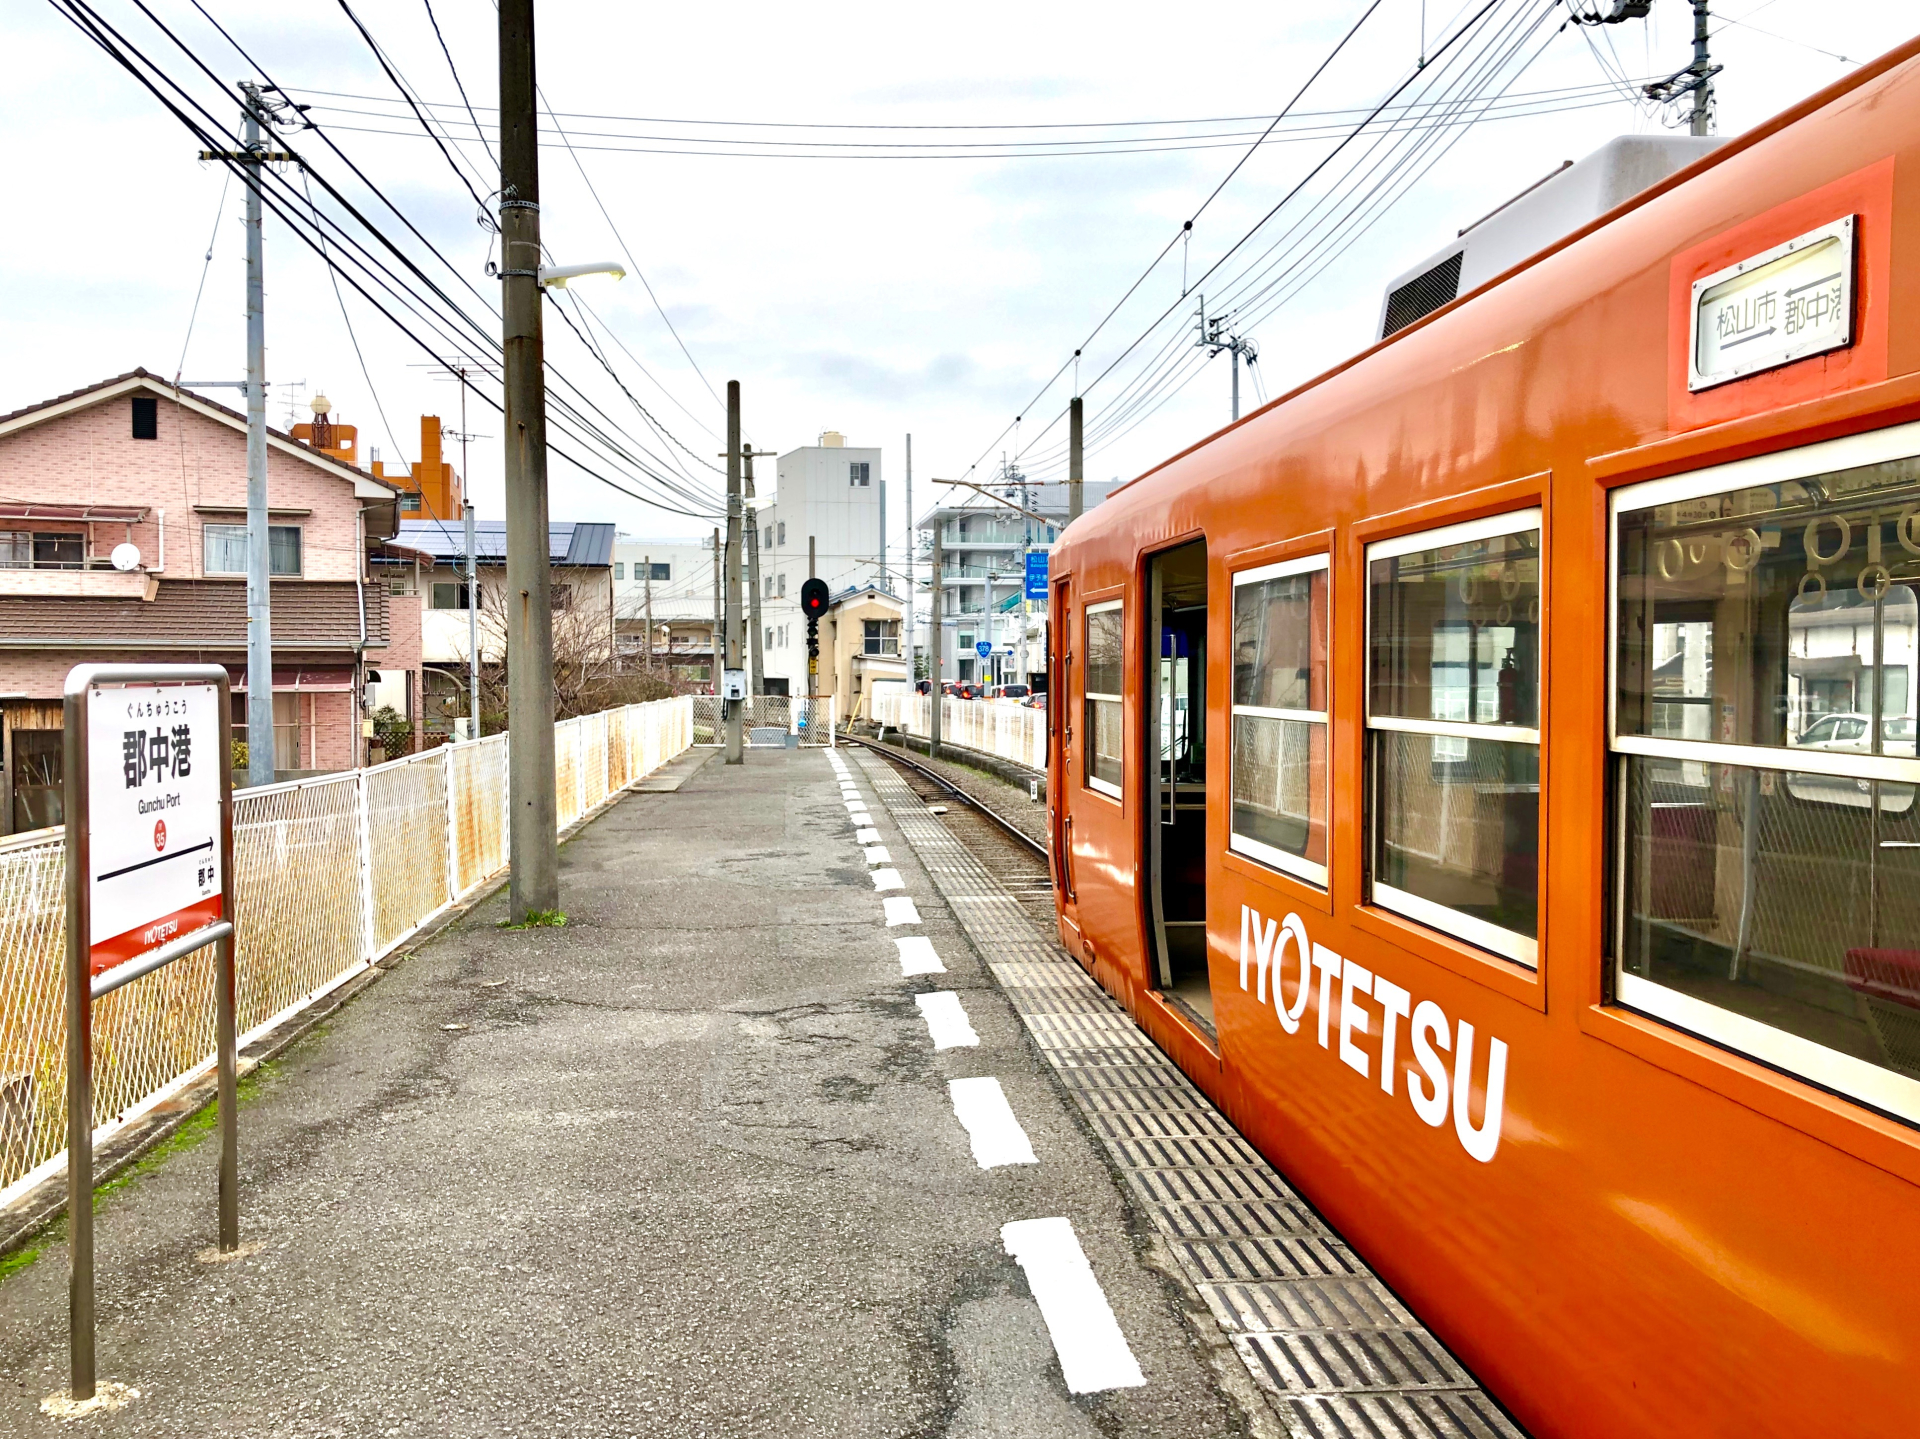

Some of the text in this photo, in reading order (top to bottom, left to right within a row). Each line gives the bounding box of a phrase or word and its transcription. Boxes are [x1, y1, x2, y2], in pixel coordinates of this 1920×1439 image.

[1716, 290, 1777, 340] 松山市
[978, 645, 990, 653] 378
[127, 699, 187, 719] ぐんちゅうこう
[122, 723, 192, 789] 郡中港
[138, 792, 181, 815] Gunchu Port
[156, 832, 165, 848] 35
[198, 865, 215, 887] 郡中
[144, 918, 178, 945] IYOTETSU
[1239, 903, 1508, 1163] IYOTETSU
